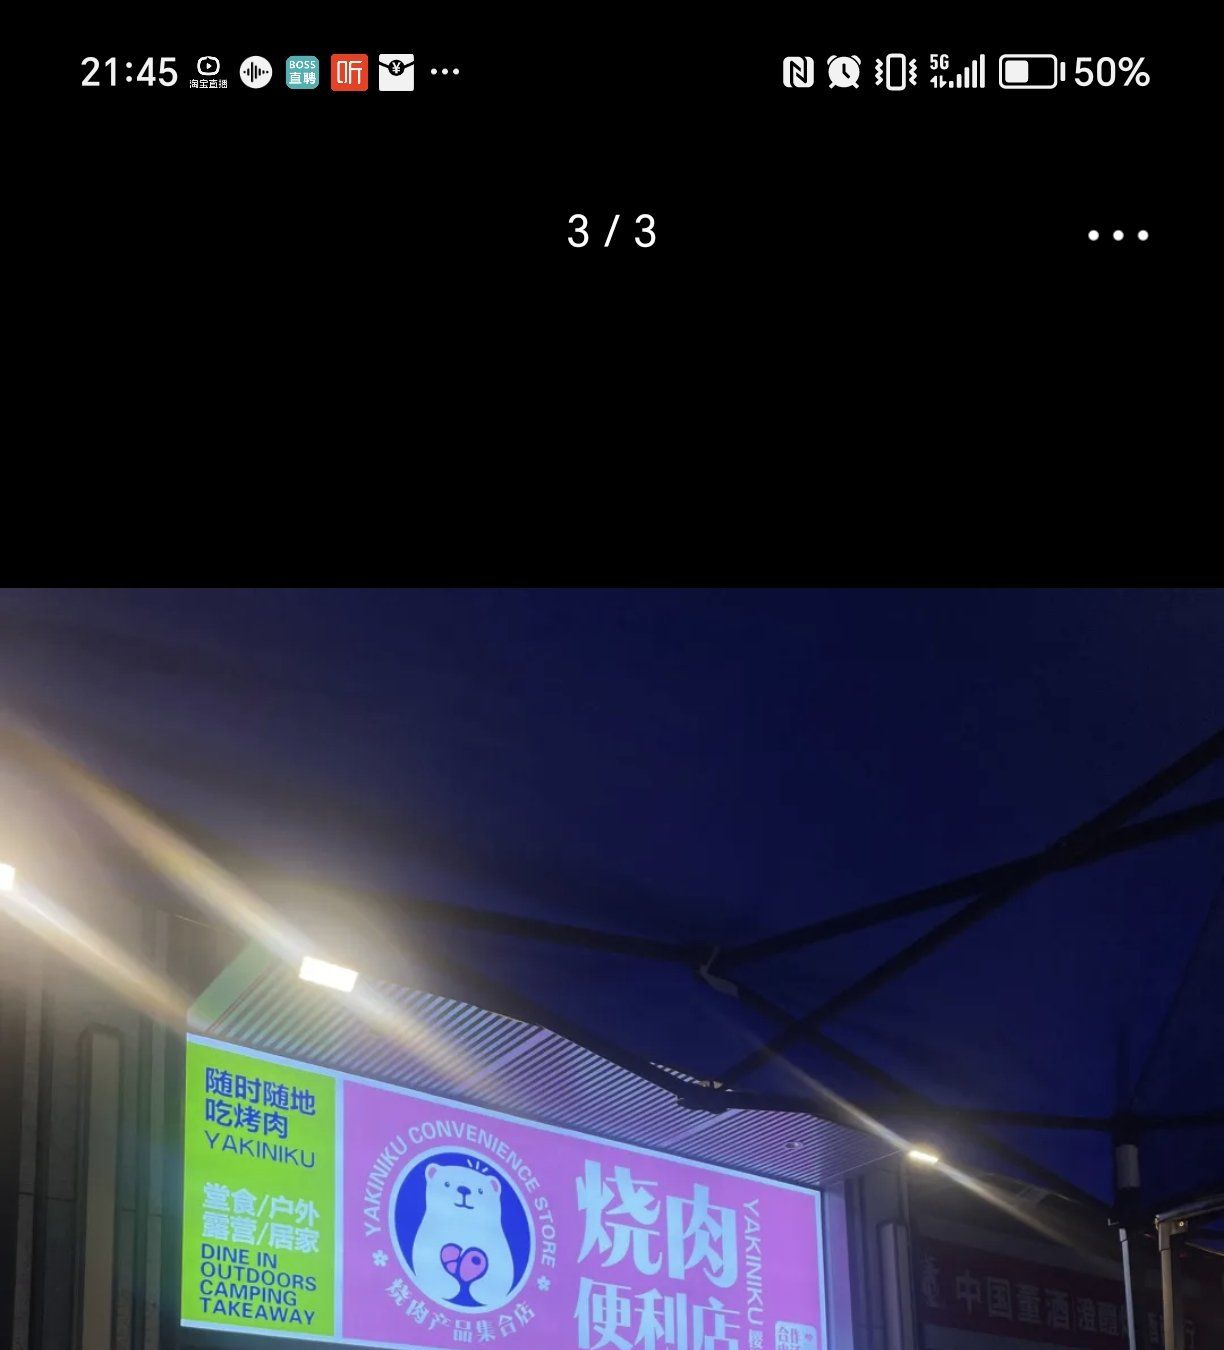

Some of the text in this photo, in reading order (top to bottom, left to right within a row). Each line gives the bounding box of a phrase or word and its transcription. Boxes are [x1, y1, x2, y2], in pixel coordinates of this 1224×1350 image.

[204, 1067, 316, 1116] 随时随地
[204, 1099, 288, 1139] 吃烤肉
[204, 1130, 316, 1169] YAKINIKU
[202, 1182, 320, 1227] 堂食/户外
[363, 1120, 557, 1269] YAKINIKU CONVENIENCE STORE
[202, 1213, 320, 1254] 露营/居家
[577, 1158, 738, 1289] 烧肉
[200, 1261, 317, 1291] OUTDOORS
[201, 1243, 277, 1269] DINE IN
[743, 1198, 764, 1326] YAKINIKU
[200, 1279, 297, 1307] CAMPING
[200, 1297, 316, 1325] TAKEAWAY
[385, 1278, 536, 1343] 烧肉产品集合店
